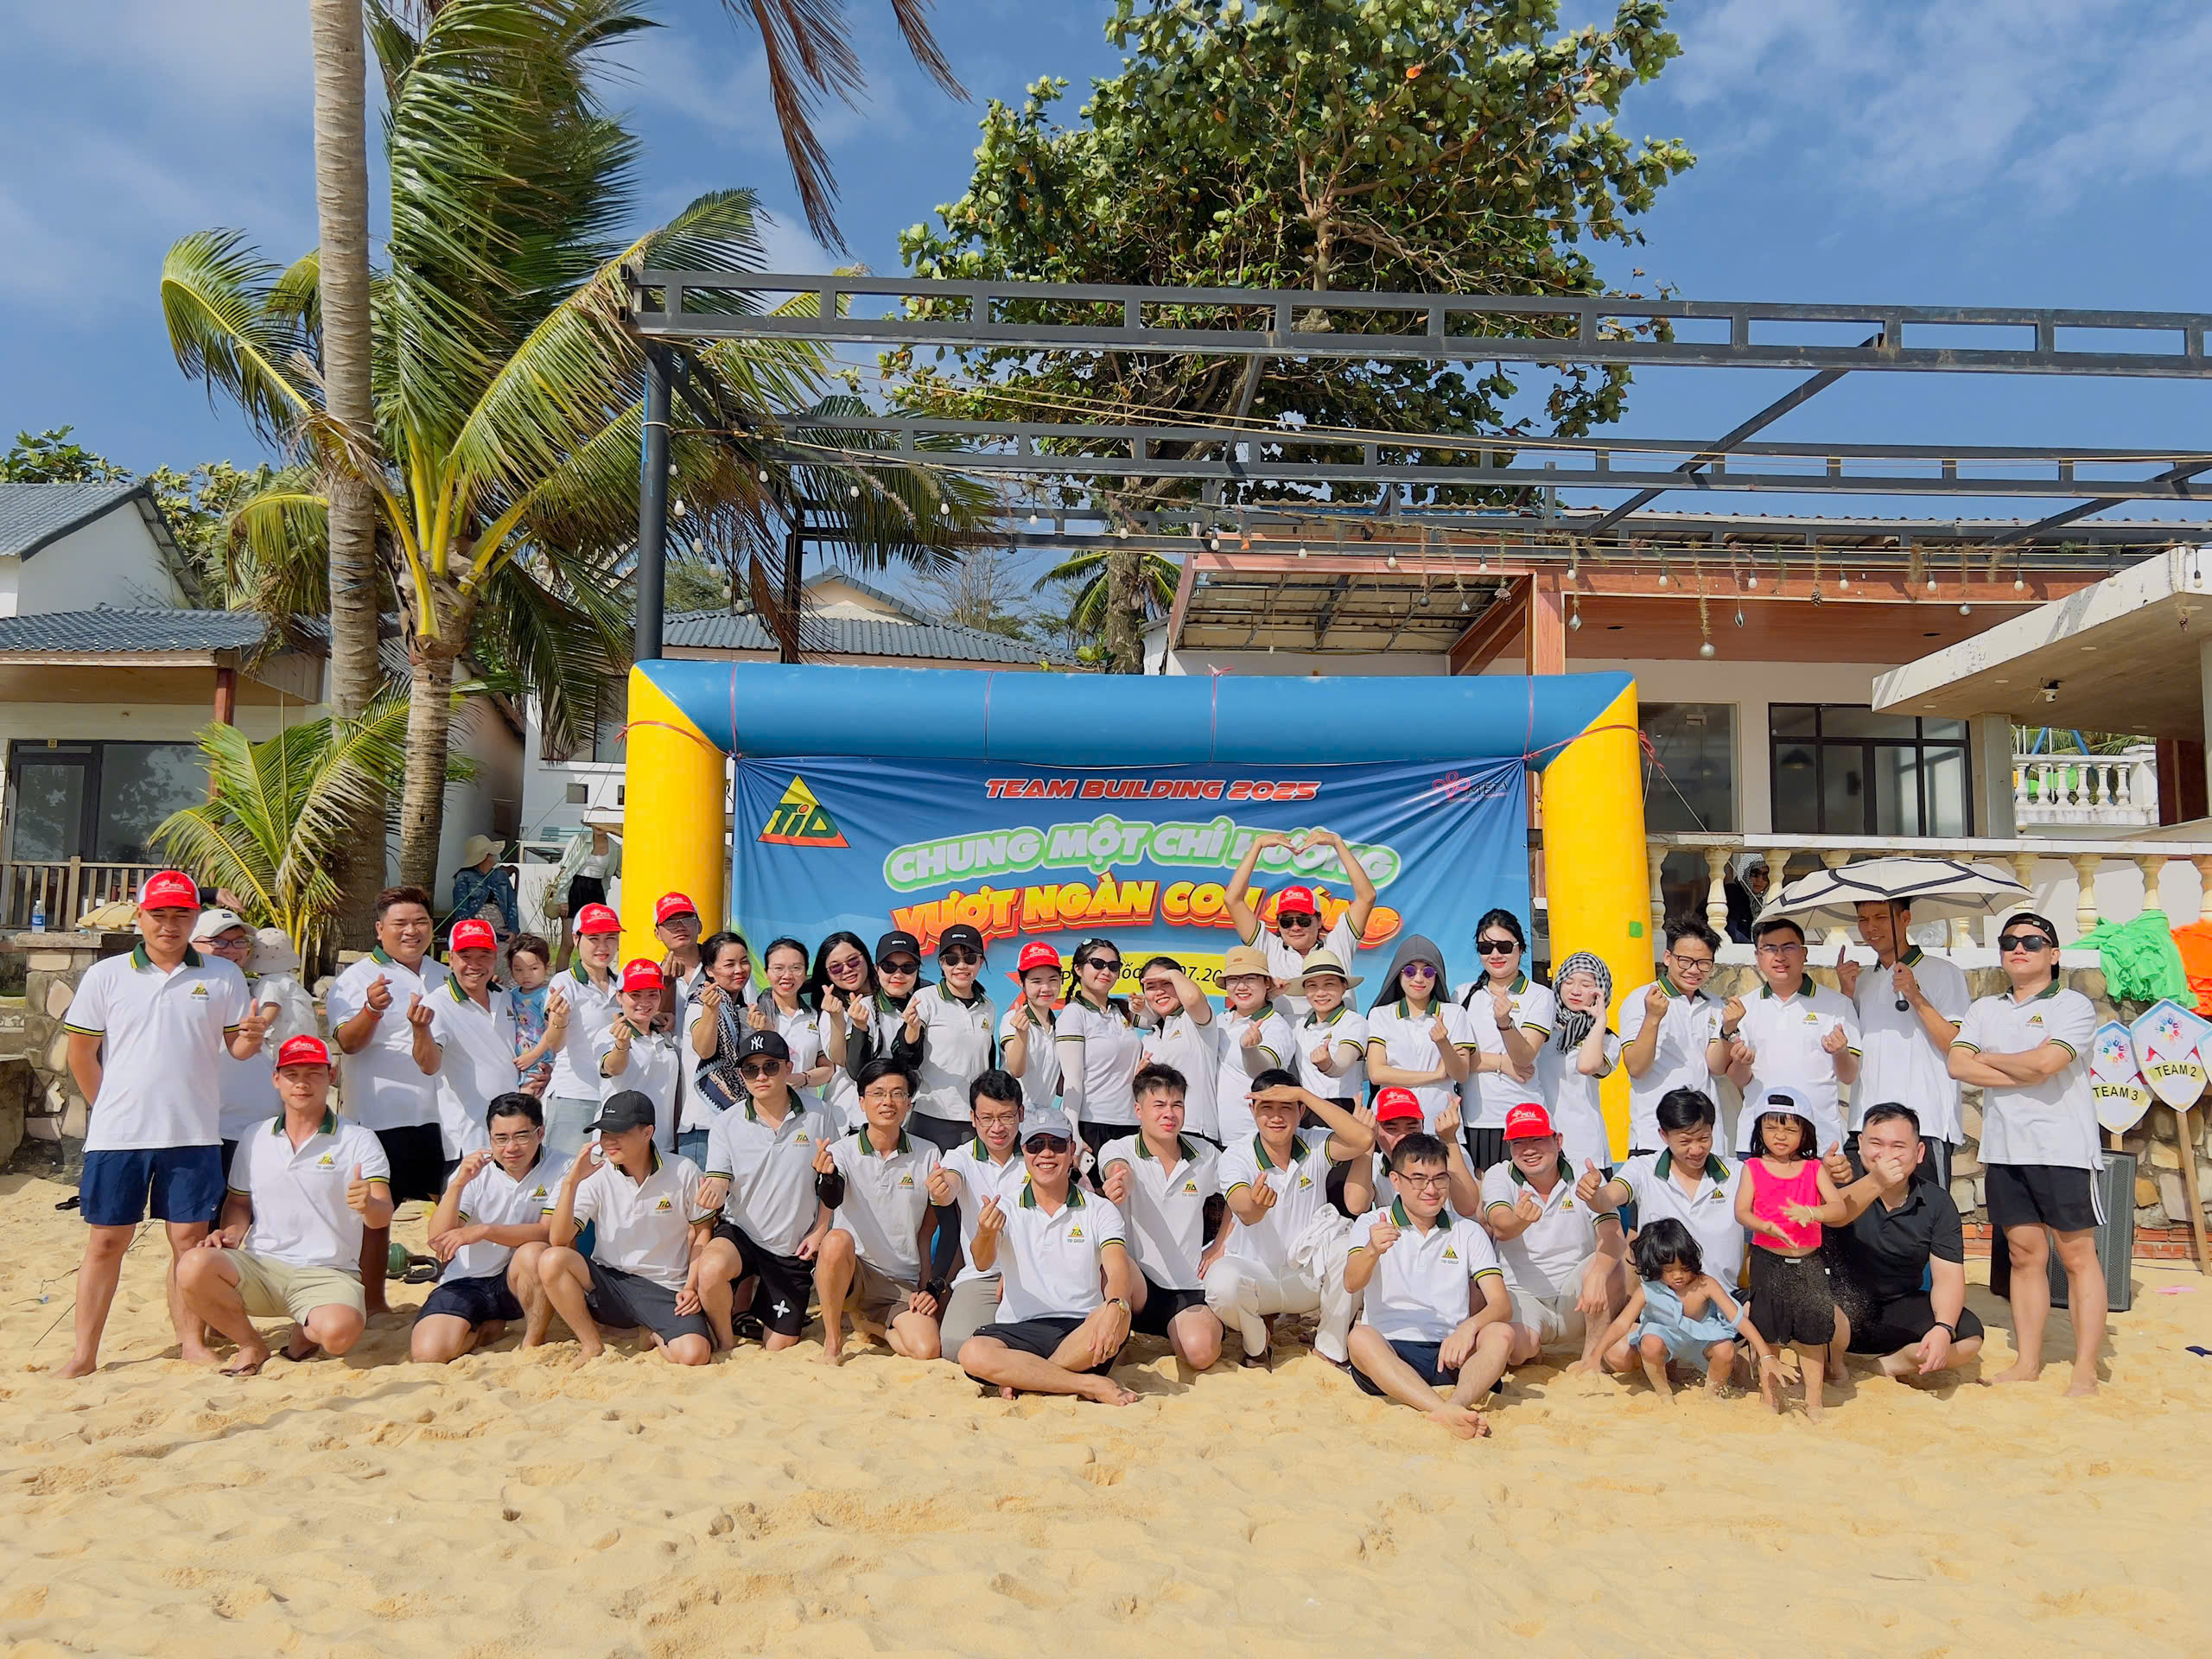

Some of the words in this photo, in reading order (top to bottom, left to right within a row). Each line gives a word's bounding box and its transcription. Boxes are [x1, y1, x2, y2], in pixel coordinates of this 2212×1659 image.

[987, 779, 1077, 799] TEAM
[1080, 779, 1224, 800] BUILDING
[1227, 781, 1320, 801] 2025
[889, 830, 1042, 884] CHUNG
[1047, 820, 1149, 866] MỘT
[1153, 821, 1228, 859] CHÍ
[1021, 871, 1158, 925] NGÀN
[2154, 1065, 2188, 1077] TEAM
[2190, 1066, 2197, 1077] 2
[2092, 1086, 2129, 1097] TEAM
[2131, 1090, 2139, 1101] 3
